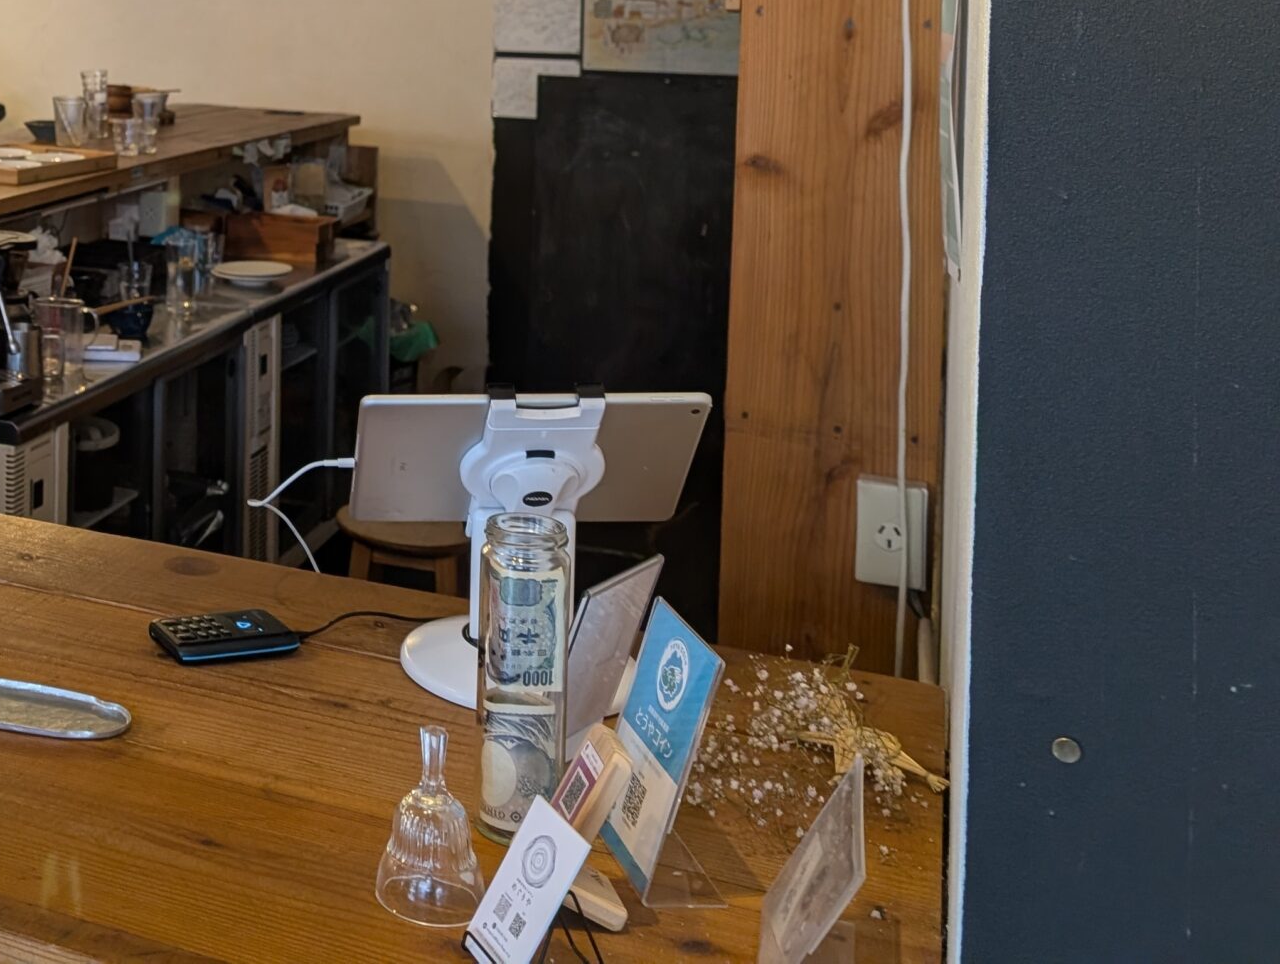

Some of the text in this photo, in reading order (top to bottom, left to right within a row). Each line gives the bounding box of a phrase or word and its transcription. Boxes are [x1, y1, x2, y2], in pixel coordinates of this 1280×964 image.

[522, 669, 554, 687] 1000
[635, 707, 673, 758] とうやコイン
